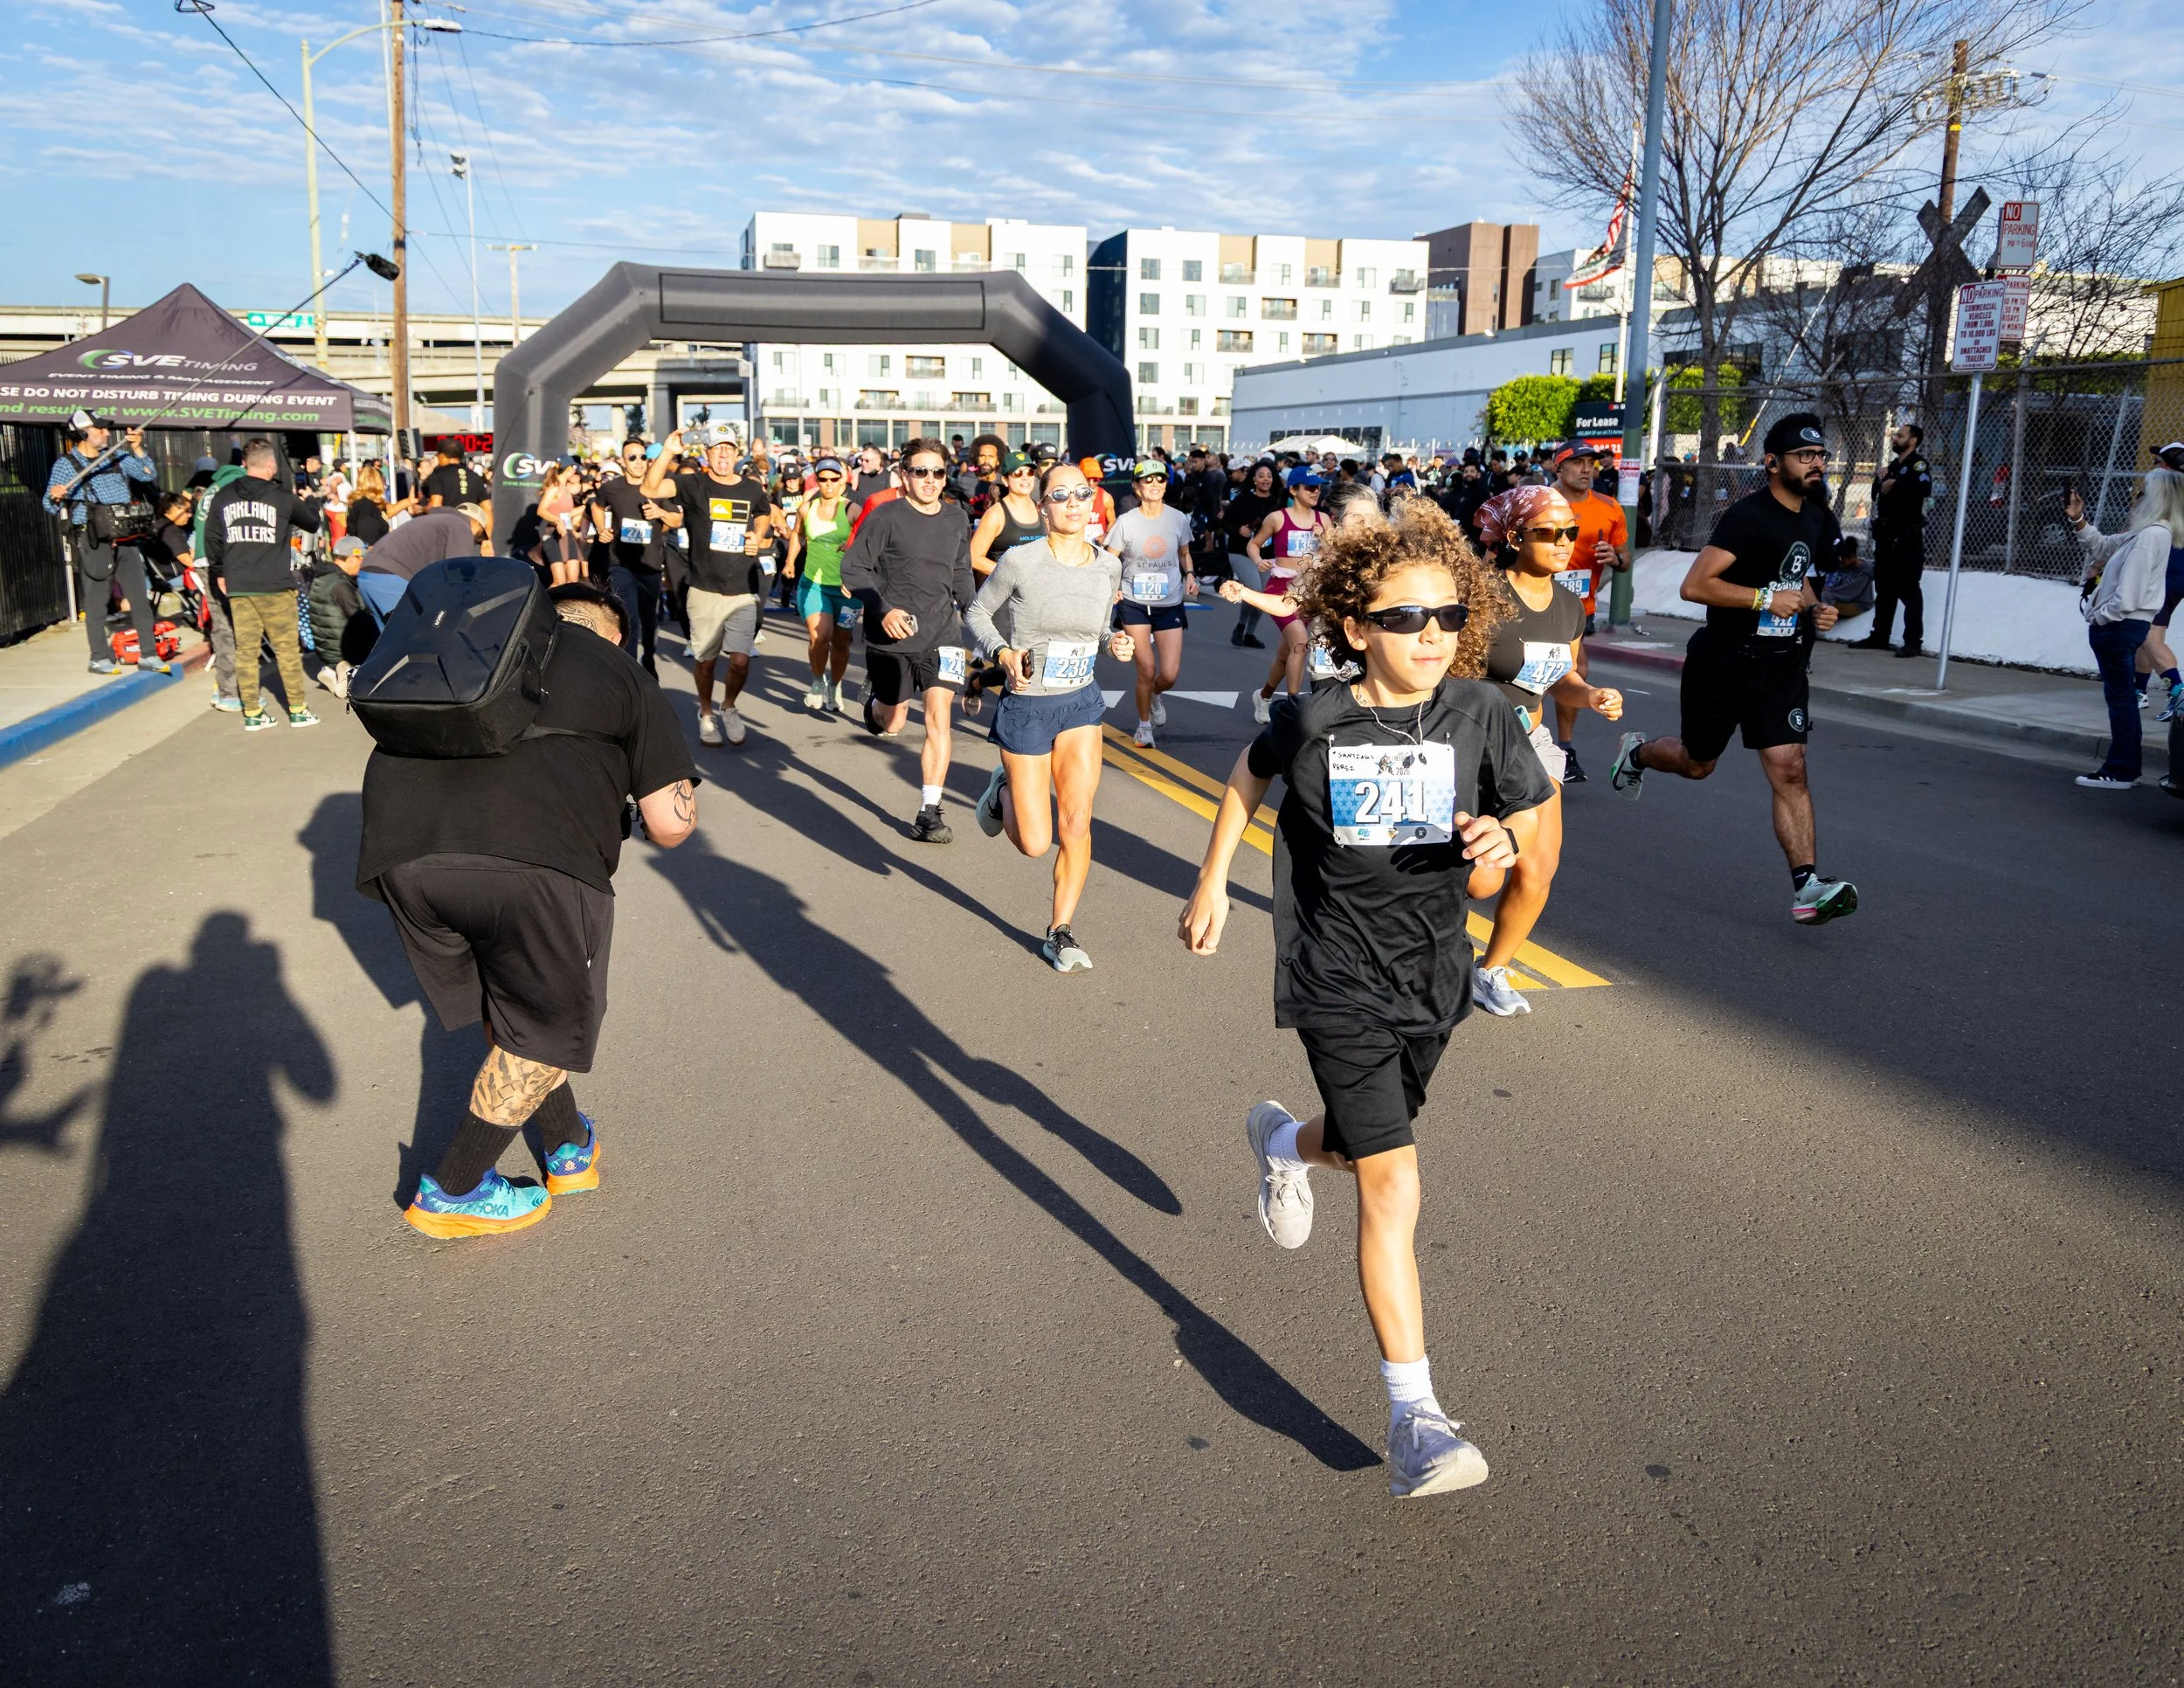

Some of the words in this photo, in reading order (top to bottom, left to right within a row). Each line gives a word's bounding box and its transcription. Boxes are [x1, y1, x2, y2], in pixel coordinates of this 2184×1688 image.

[2006, 204, 2021, 219] NO
[2004, 224, 2035, 235] PARKING
[1961, 288, 1974, 303] NO
[1975, 287, 2004, 299] PARKING
[1966, 303, 1997, 312] COMMERCIAL
[1960, 346, 1992, 355] UNATTACHED
[24, 387, 50, 398] DO
[52, 388, 90, 399] NOT
[92, 390, 160, 401] DISTURB
[162, 391, 220, 404] TIMING
[223, 394, 284, 405] DURING
[287, 395, 337, 406] EVENT
[96, 405, 117, 416] at
[1576, 417, 1593, 428] For
[1593, 417, 1619, 427] Lease
[516, 459, 556, 475] SV
[224, 501, 277, 528] OAKLAND
[1141, 583, 1162, 595] 120
[1055, 657, 1089, 679] 238
[1531, 661, 1565, 684] 472
[1355, 780, 1428, 824] 241
[473, 1202, 509, 1217] HOKA
